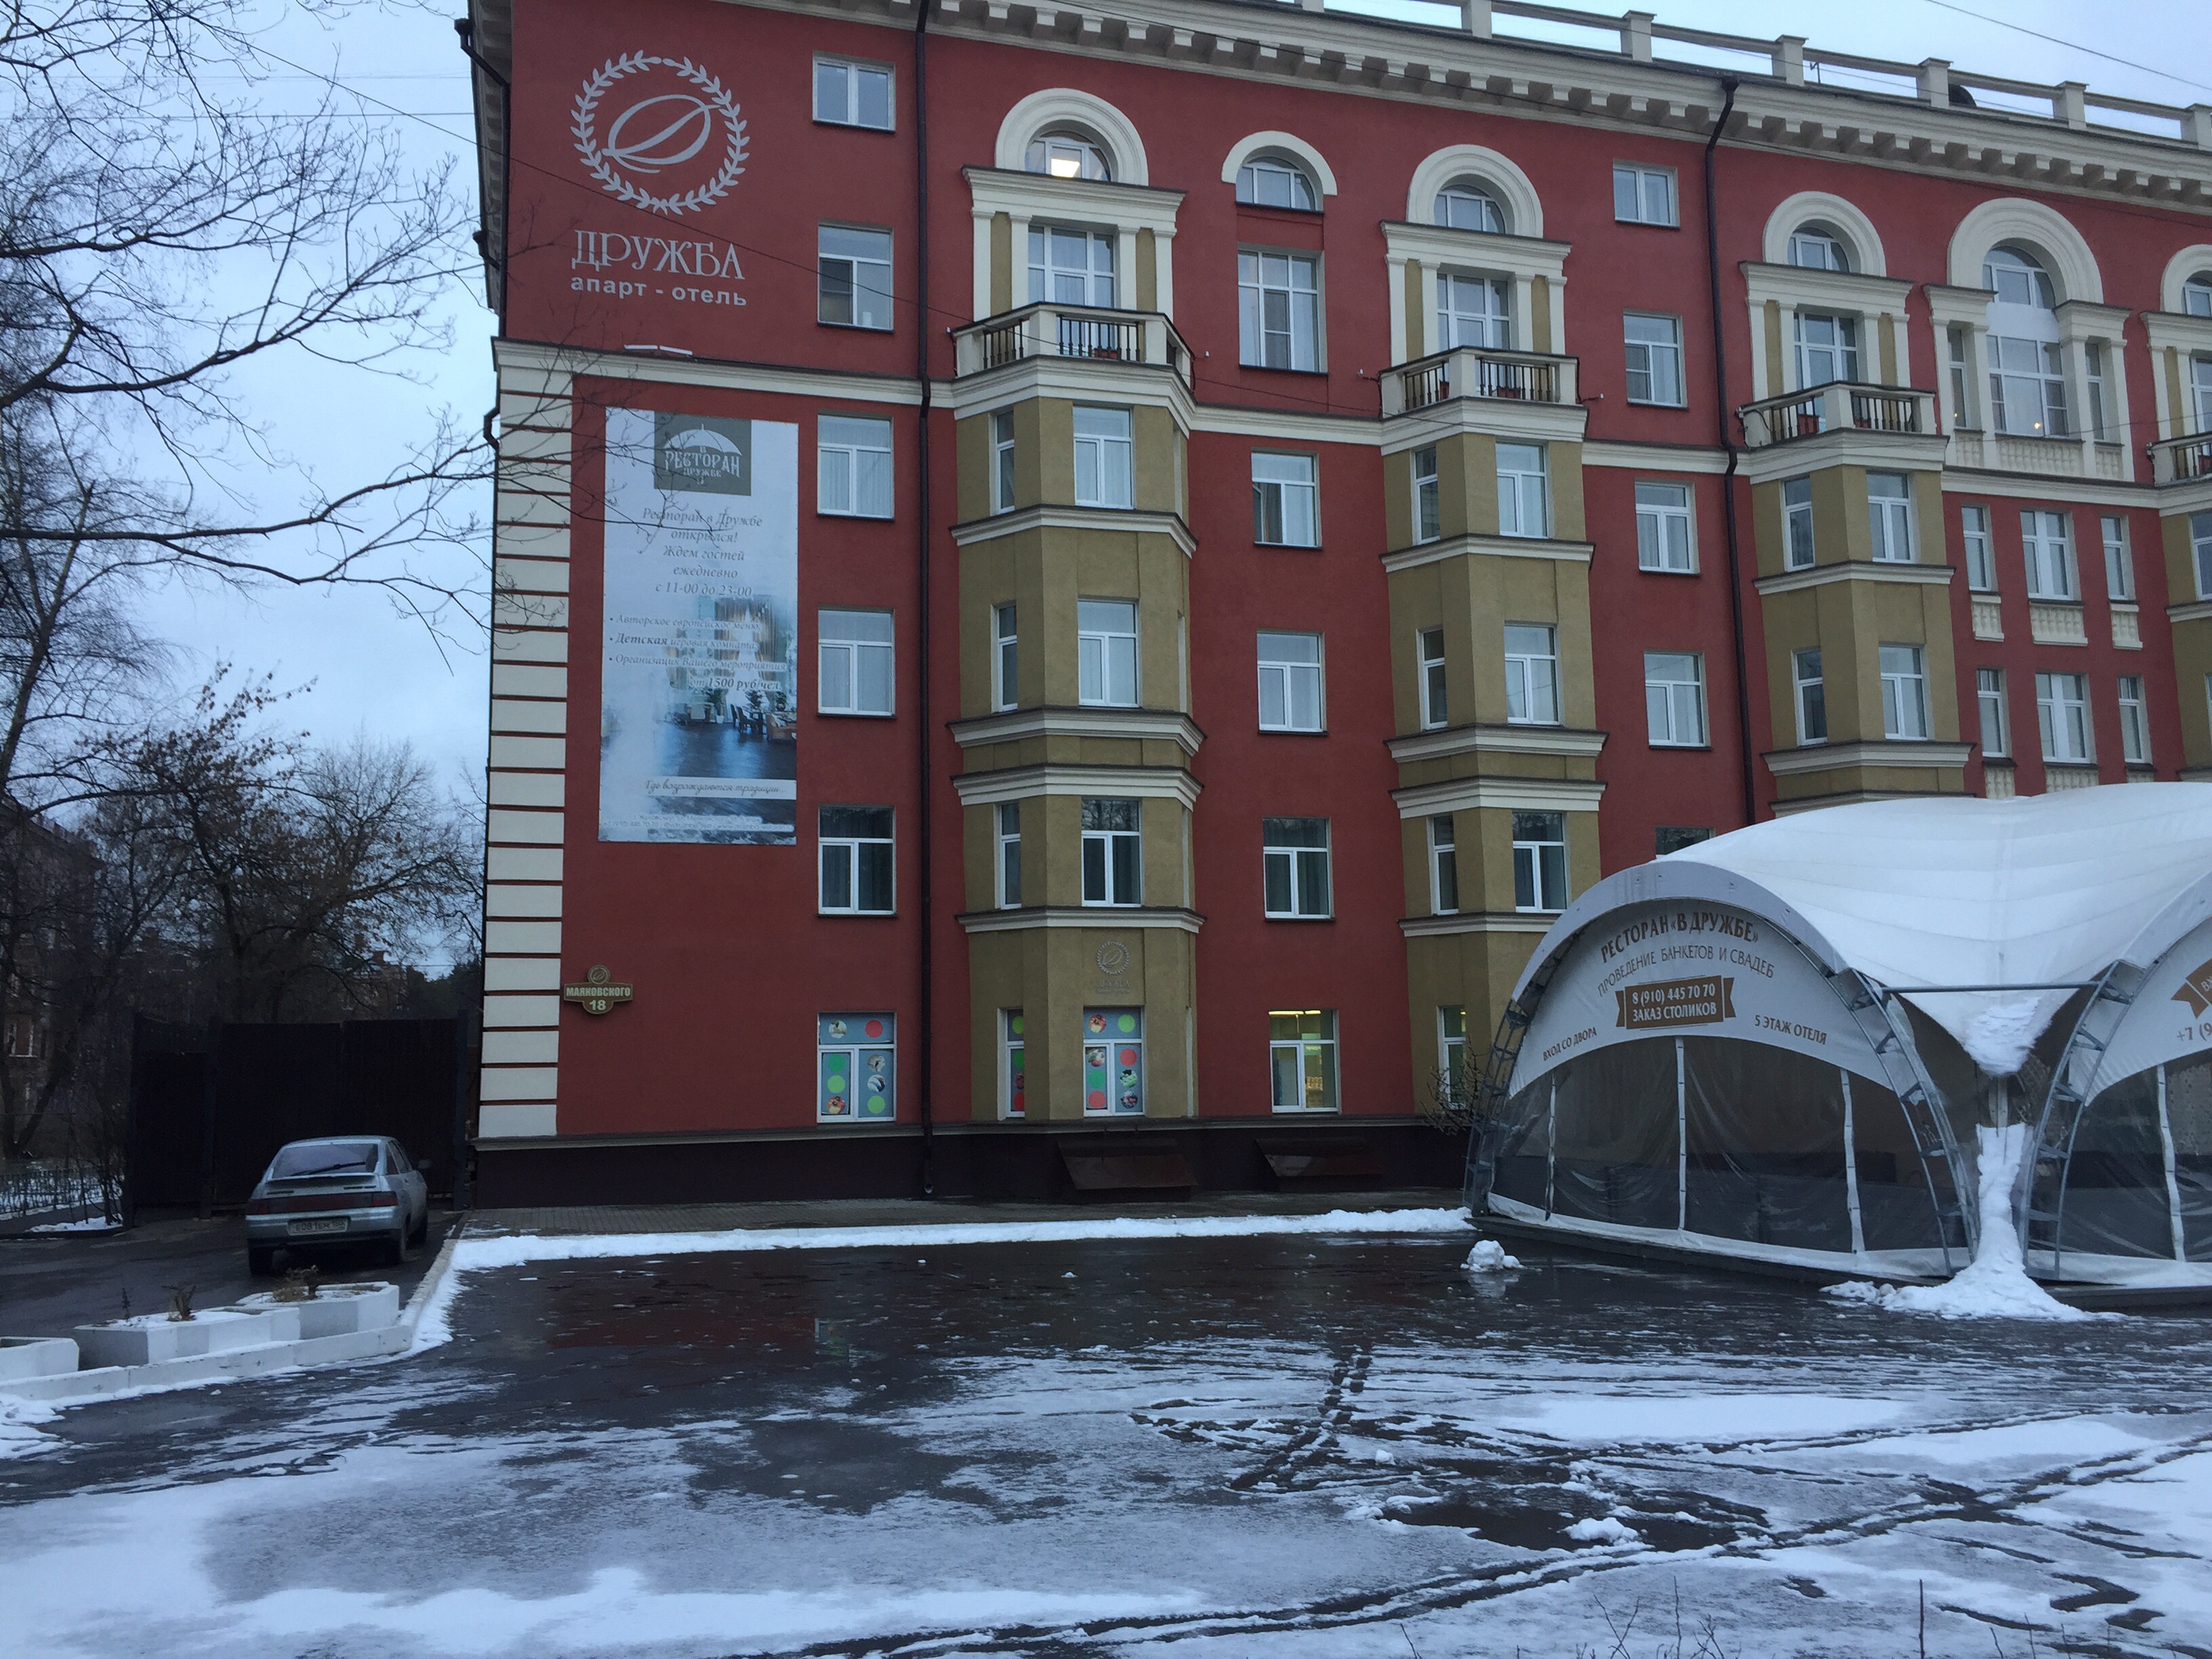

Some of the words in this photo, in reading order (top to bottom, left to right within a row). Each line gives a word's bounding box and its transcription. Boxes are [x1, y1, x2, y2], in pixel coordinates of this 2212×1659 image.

[571, 230, 745, 280] ДРУЖБА
[571, 276, 647, 300] апарт
[672, 287, 747, 306] отель
[664, 450, 741, 478] РЕСТОРАН
[683, 468, 721, 477] ДРУЖБЕ
[716, 512, 762, 528] Дружбе
[671, 531, 738, 544] открылся!
[663, 546, 698, 558] Ждем
[701, 551, 745, 561] гостей
[673, 565, 738, 579] ежедневно
[665, 582, 699, 594] 11-00
[701, 583, 716, 595] до
[718, 585, 752, 597] 23-00
[616, 615, 669, 627] Авторское
[615, 632, 668, 645] Детская
[709, 678, 734, 688] 1500
[1600, 914, 1668, 963] РЕСТОРАН
[1689, 912, 1759, 943] ДРУЖБЕ»
[1597, 951, 1656, 997] ПРОВЕДЕНИЕ
[1660, 945, 1714, 962] БАНКЕТОВ
[1719, 947, 1727, 962] И
[1729, 949, 1775, 978] СВАДЕБ
[566, 987, 631, 997] МАЯКОВСКОГО
[1632, 991, 1639, 1004] 8
[1641, 989, 1665, 1007] (910)
[1667, 987, 1685, 1000] 445
[1687, 985, 1700, 999] 70
[1702, 983, 1715, 997] 70
[589, 1000, 607, 1010] 18
[1633, 1007, 1662, 1022] ЗАКАЗ
[1663, 1002, 1717, 1019] СТОЛИКОВ
[1755, 1015, 1761, 1027] 5
[1763, 1017, 1791, 1034] ЭТАЖ
[1793, 1024, 1827, 1045] ОТЕЛЯ
[2177, 1027, 2194, 1042] +7
[1542, 1043, 1561, 1061] ВХОД
[1561, 1037, 1572, 1050] СО
[1574, 1027, 1597, 1047] ДВОРА
